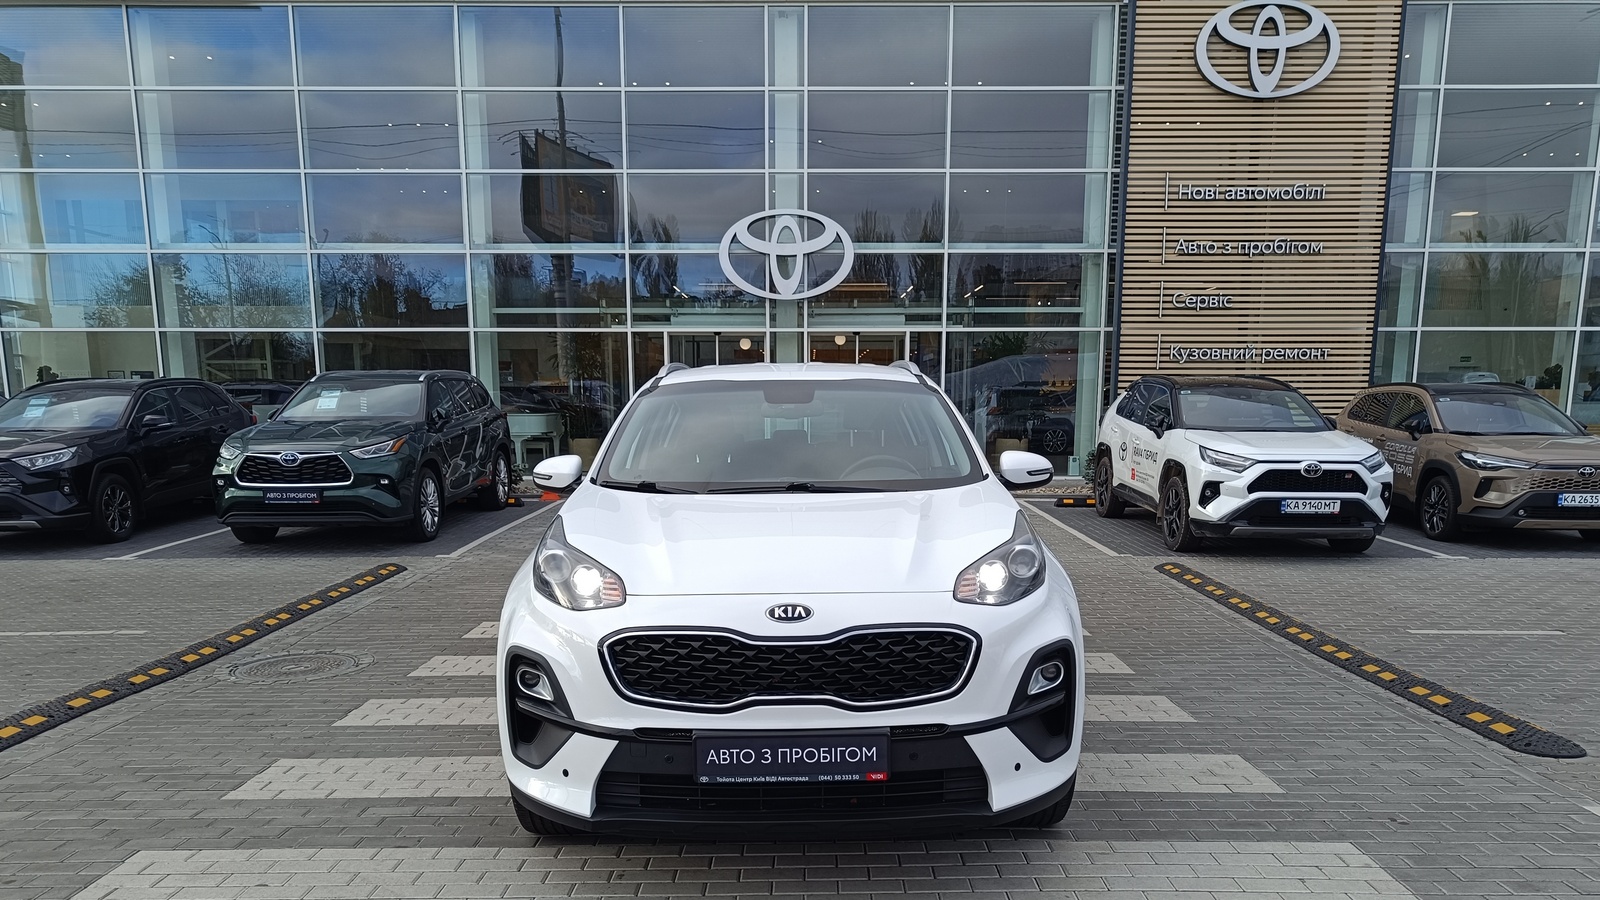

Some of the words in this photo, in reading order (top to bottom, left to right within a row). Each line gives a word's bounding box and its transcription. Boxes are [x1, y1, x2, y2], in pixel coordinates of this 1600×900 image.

[1178, 184, 1219, 200] Нові
[1225, 183, 1327, 200] автомобілі
[1174, 238, 1218, 254] Авто
[1222, 242, 1232, 254] з
[1238, 237, 1324, 258] пробігом
[1172, 292, 1233, 312] Сервіс
[1169, 344, 1256, 364] Кузовний
[1261, 348, 1331, 364] ремонт
[1301, 501, 1323, 511] 9140
[1578, 495, 1599, 504] 2635
[773, 606, 807, 618] KIA
[706, 749, 755, 764] АВТО
[761, 749, 772, 764] З
[778, 746, 877, 764] ПРОБІГОМ
[753, 775, 765, 783] Київ
[777, 775, 809, 783] Автострада
[818, 774, 833, 782] (044)
